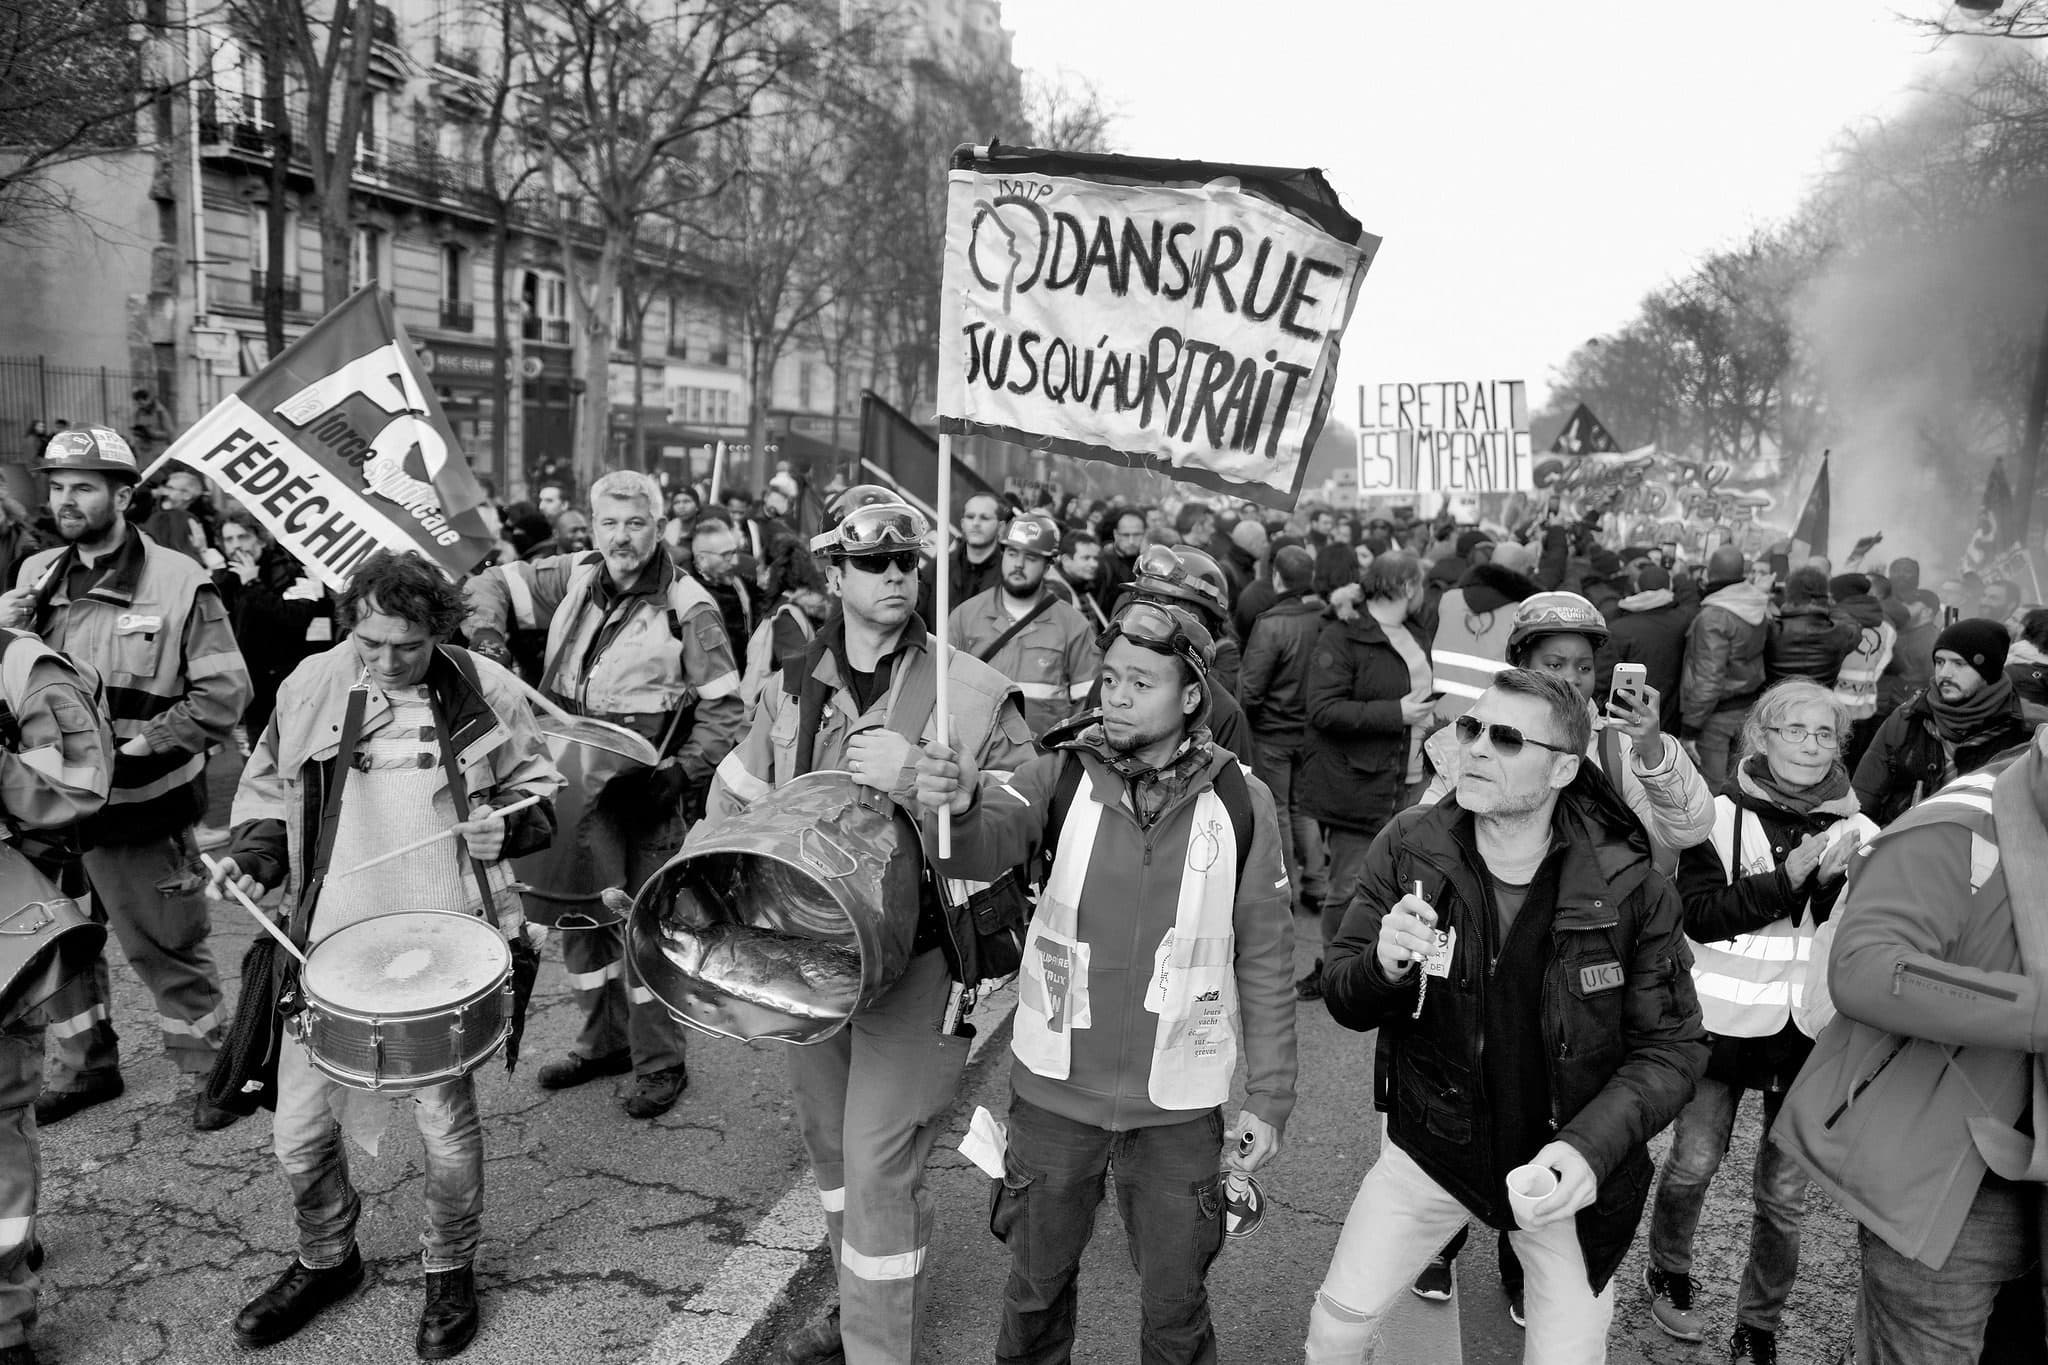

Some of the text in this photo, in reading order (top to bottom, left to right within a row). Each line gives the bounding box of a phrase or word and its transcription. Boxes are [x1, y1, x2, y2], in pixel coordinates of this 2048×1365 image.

[1044, 211, 1343, 341] DANS RUE
[1358, 379, 1525, 431] LE RETRAIT
[1361, 429, 1409, 490] EST
[1410, 427, 1529, 491] IMPERATIF
[1583, 965, 1622, 988] UKT
